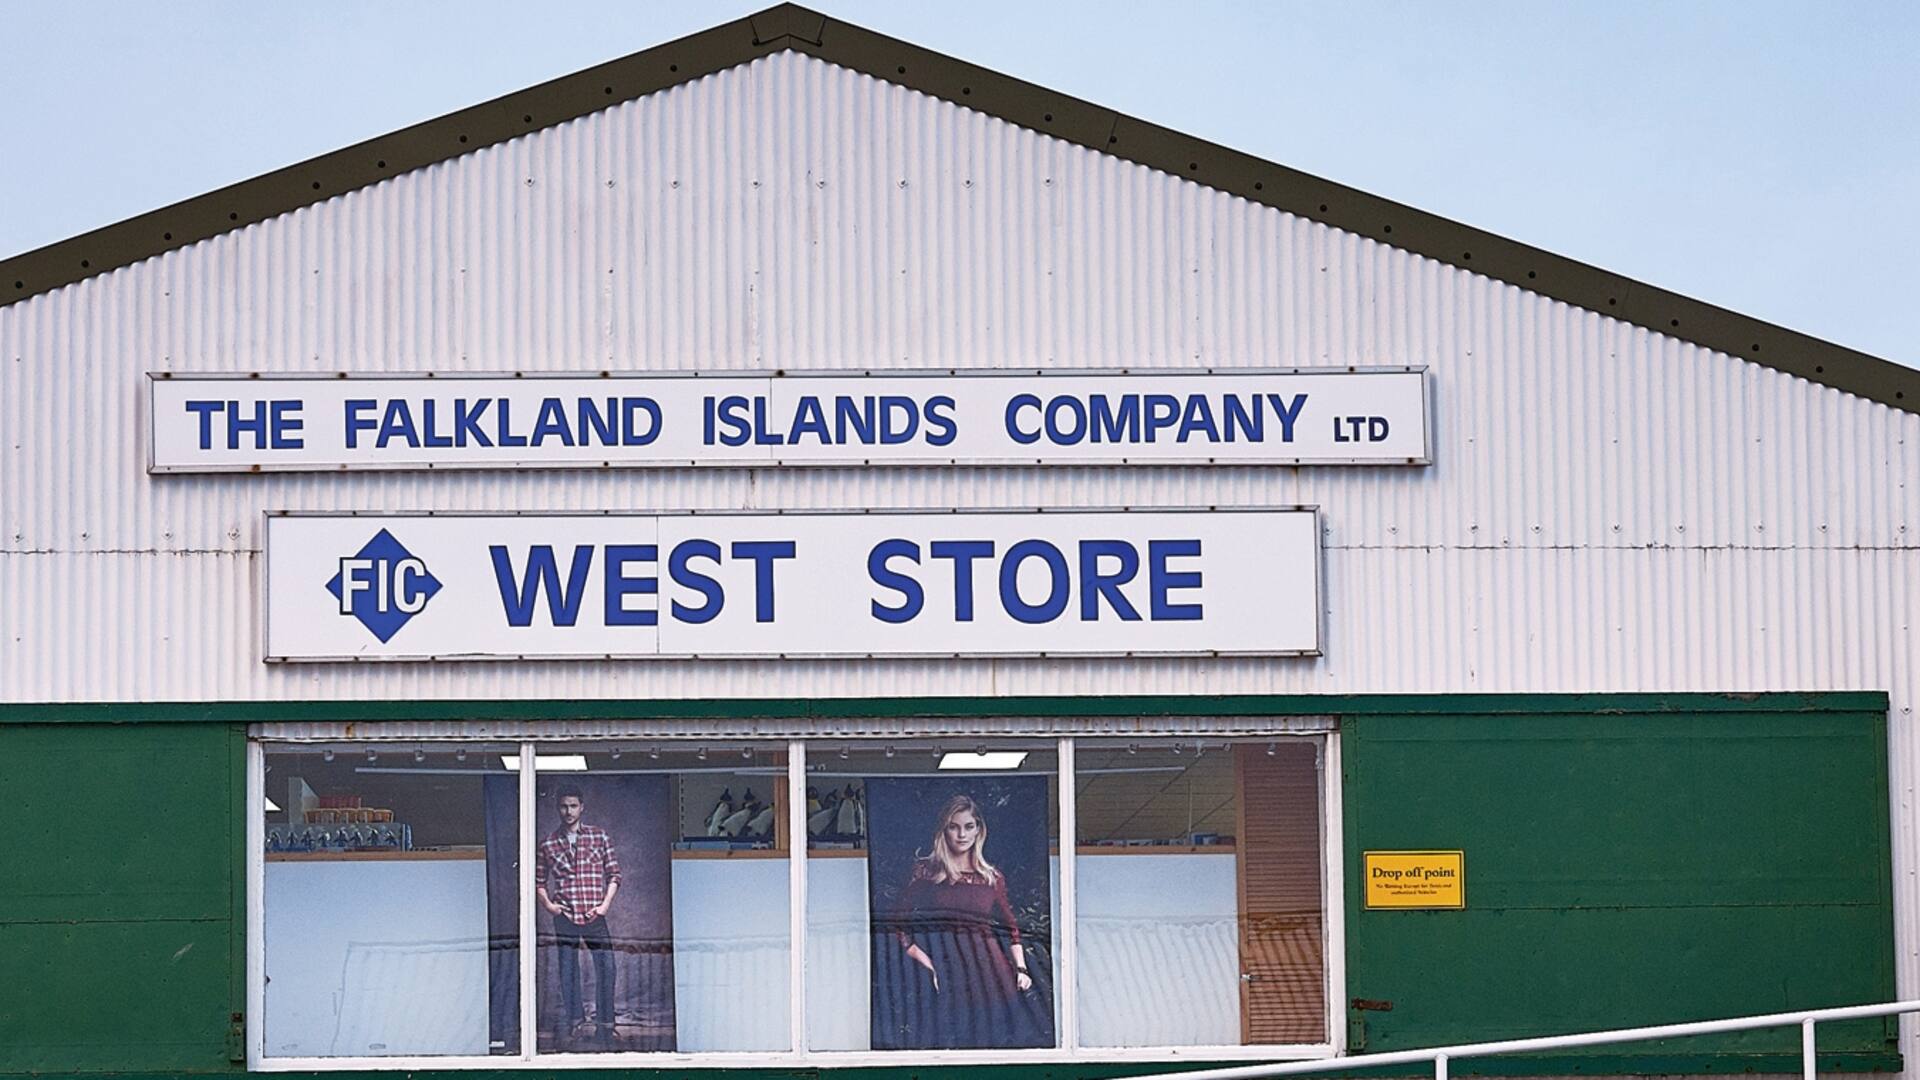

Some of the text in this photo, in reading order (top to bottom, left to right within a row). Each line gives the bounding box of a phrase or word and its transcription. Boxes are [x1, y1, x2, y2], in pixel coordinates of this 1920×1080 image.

[186, 394, 1389, 449] THE FALKLAND ISLANDS COMPANY LTD
[340, 557, 427, 615] FIC
[489, 538, 1203, 627] WEST STORE
[1373, 866, 1455, 880] Drop off point
